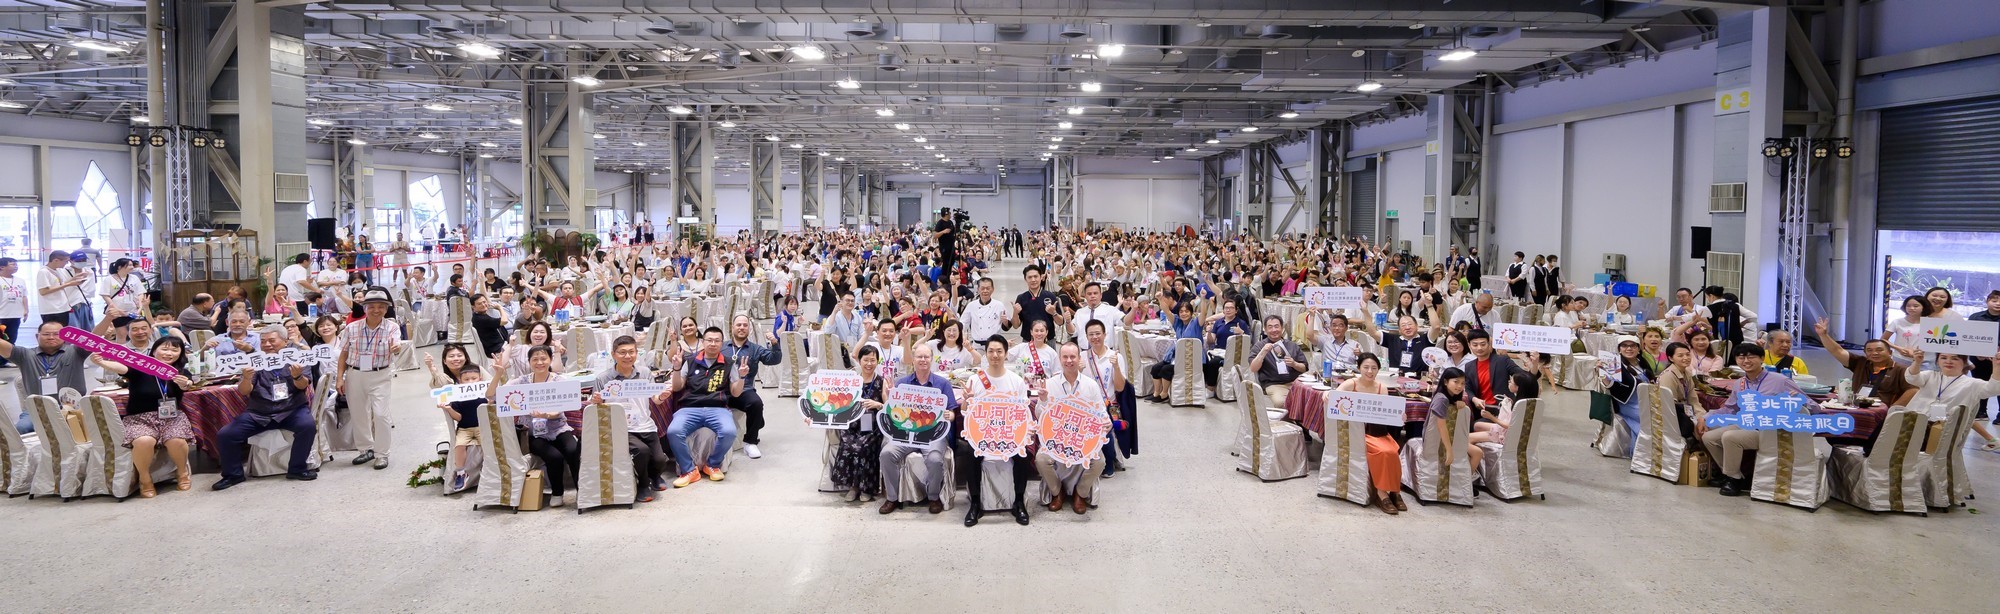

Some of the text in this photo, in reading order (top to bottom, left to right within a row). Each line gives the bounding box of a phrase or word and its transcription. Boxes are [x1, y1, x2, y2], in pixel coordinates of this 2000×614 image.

[1720, 90, 1750, 111] C 3
[1924, 337, 1959, 346] TAIPEI
[219, 346, 332, 373] 八一原住民族週
[811, 377, 861, 387] 山河海食紀
[892, 391, 944, 407] 山河海食紀
[1741, 393, 1803, 412] 臺北市
[972, 405, 1027, 422] 山河海
[1049, 404, 1103, 436] 山河海
[1709, 413, 1850, 432] 八一原住民族服日
[980, 424, 1014, 440] 食紀
[1052, 425, 1085, 449] 食紀
